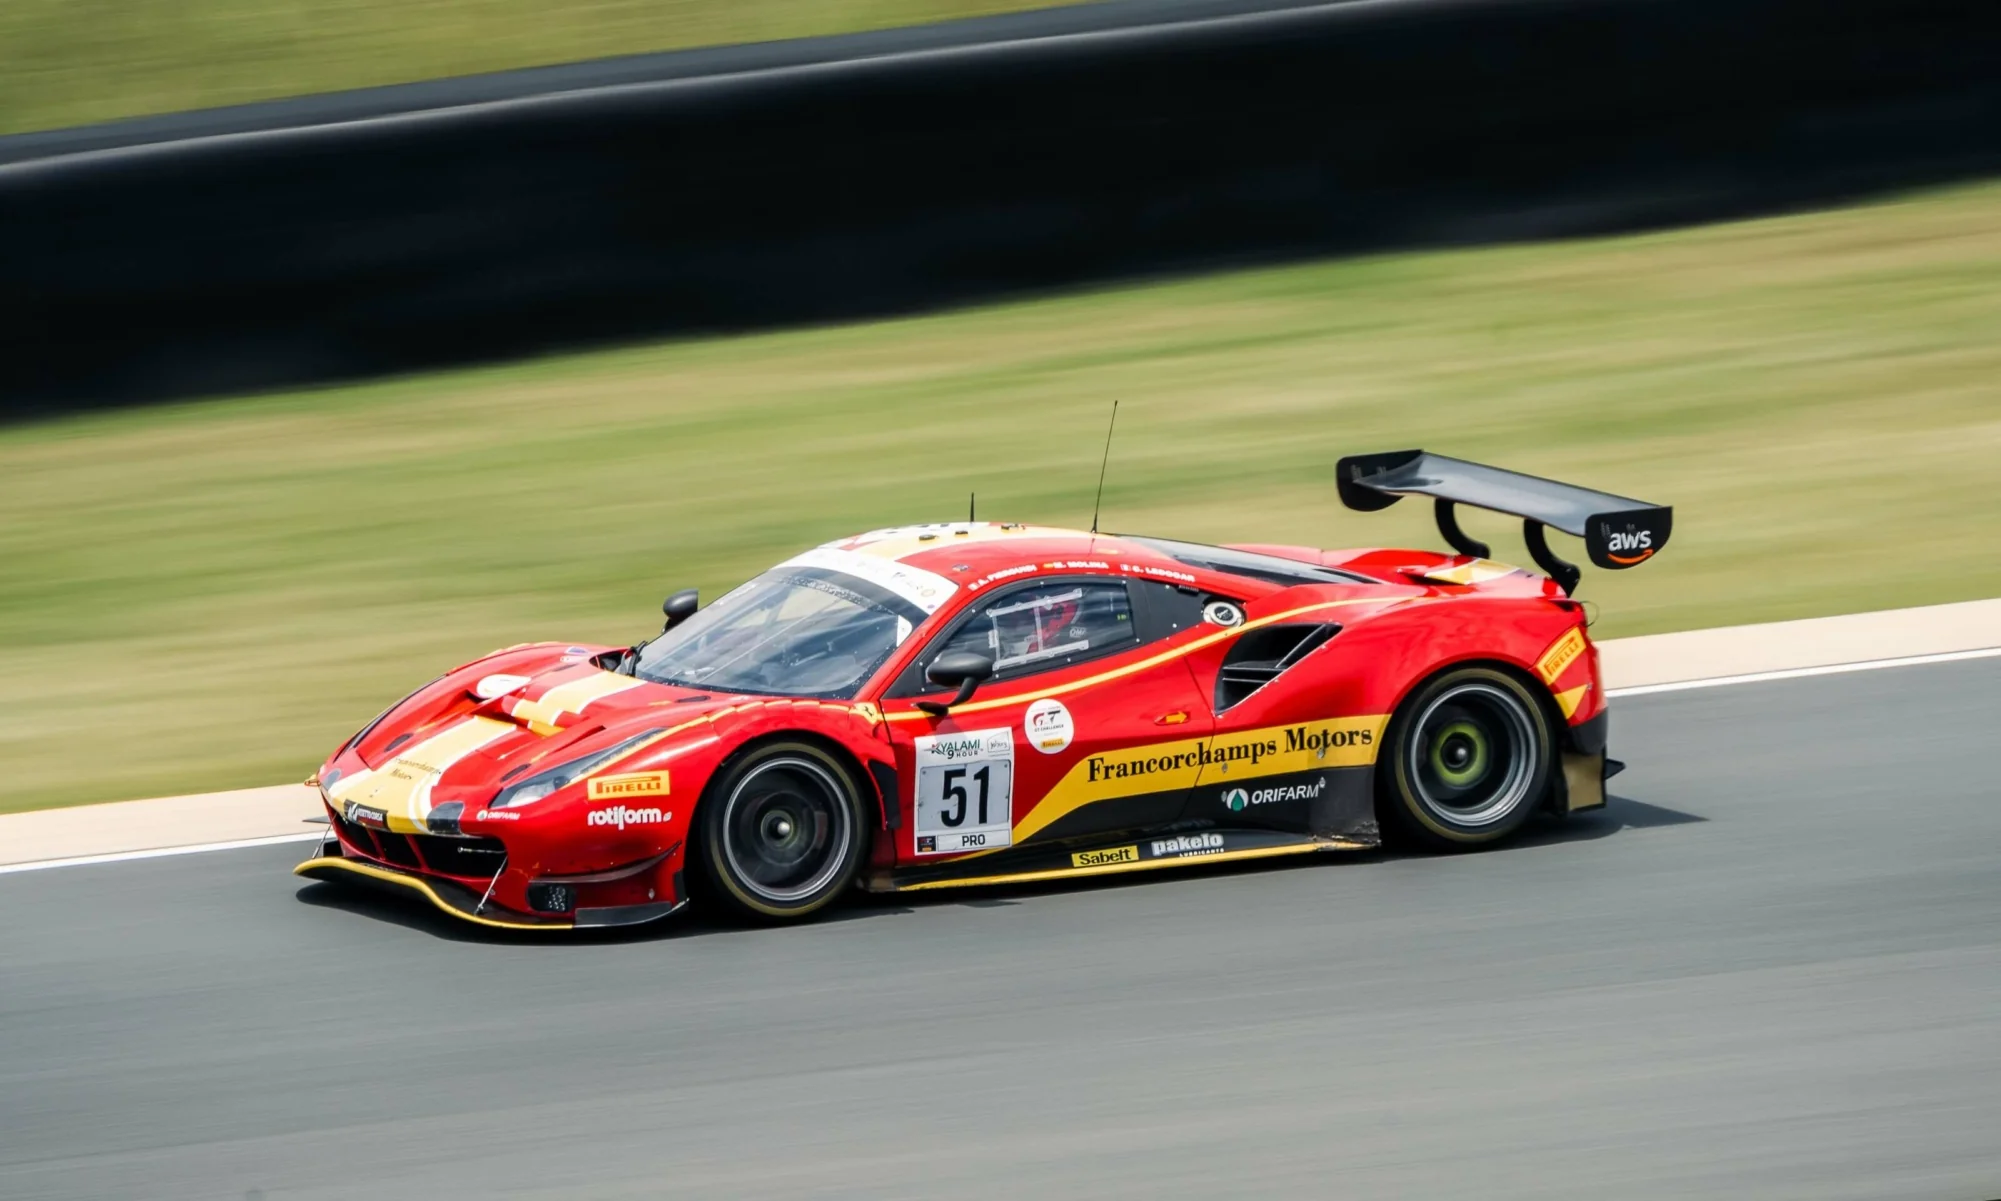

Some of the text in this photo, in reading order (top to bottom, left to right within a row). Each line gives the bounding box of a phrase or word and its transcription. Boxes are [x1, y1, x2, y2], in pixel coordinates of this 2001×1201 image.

[1608, 530, 1652, 551] aws
[1544, 635, 1580, 676] PIRELLI
[931, 739, 981, 755] KYALAMI
[947, 750, 979, 759] 9 HOUR
[1087, 726, 1373, 783] Francorchamps Motors
[596, 776, 661, 794] PIRELLI
[1251, 784, 1319, 805] ORIFARM
[941, 766, 990, 828] 51
[588, 805, 662, 830] rotiform
[962, 834, 986, 846] PRO
[1151, 833, 1225, 856] pakelo
[1079, 849, 1131, 865] Sabelt
